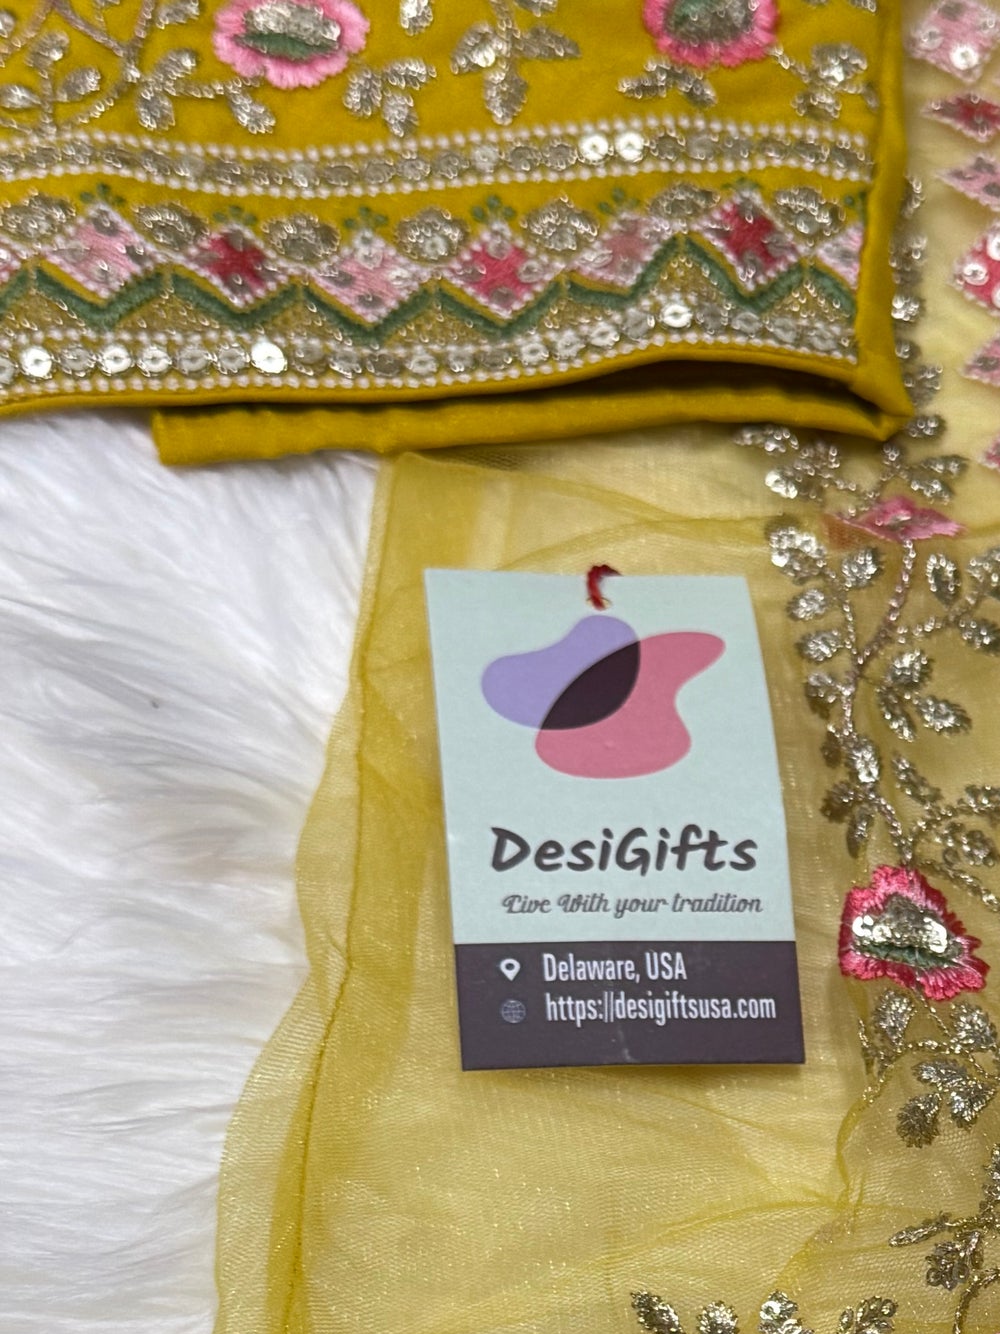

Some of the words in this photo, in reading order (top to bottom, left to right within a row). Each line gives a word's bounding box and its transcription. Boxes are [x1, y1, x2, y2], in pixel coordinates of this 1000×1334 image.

[490, 823, 758, 876] DesiGifts
[614, 898, 669, 919] your
[671, 893, 763, 913] tradition
[542, 953, 641, 983] Delaware,
[645, 952, 688, 980] USA
[545, 991, 777, 1027] https://desigiftsusa.com
